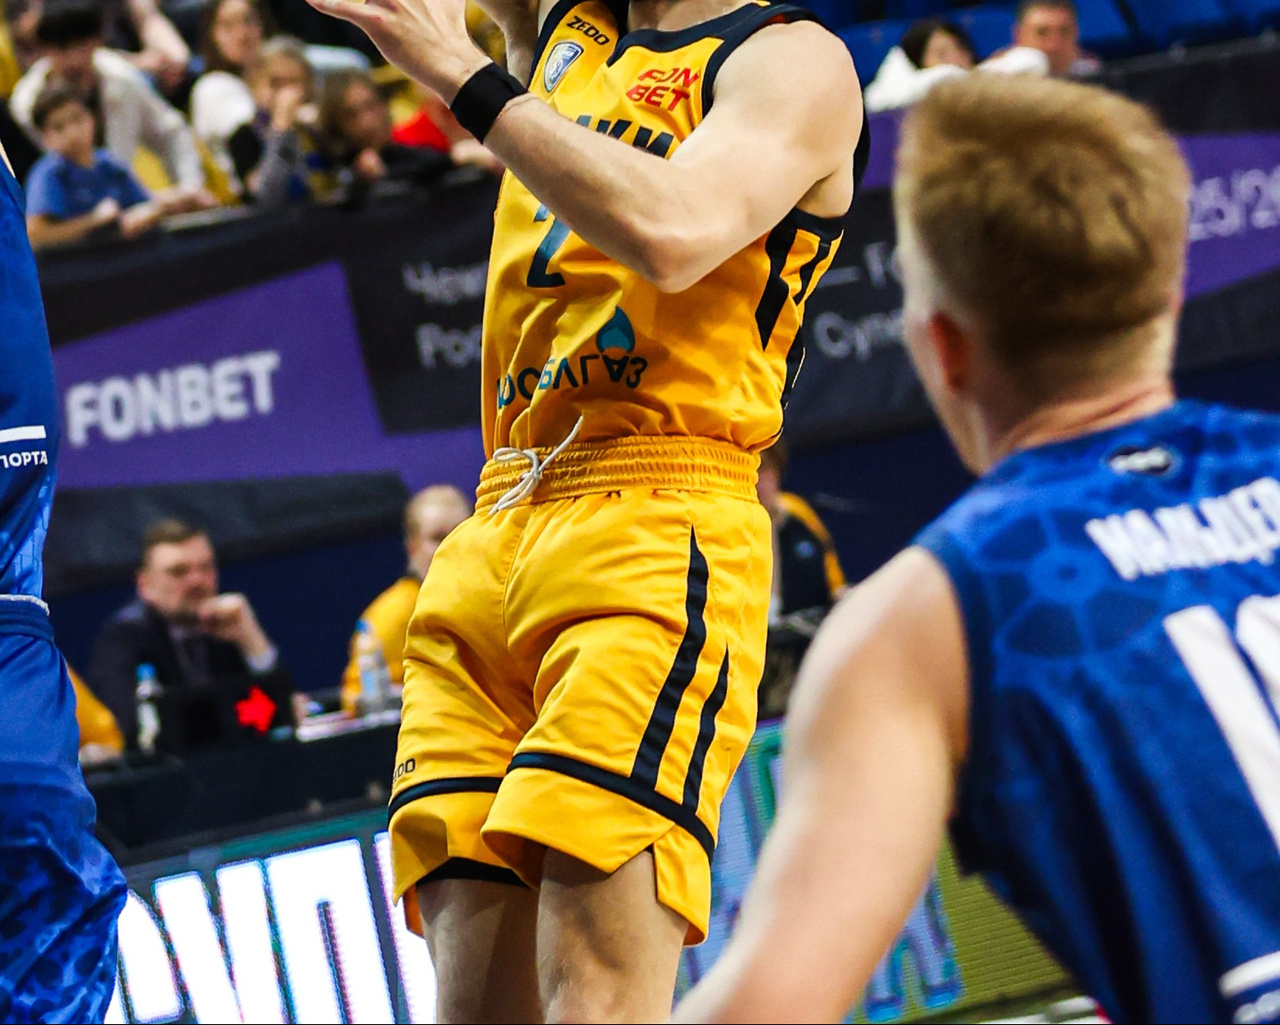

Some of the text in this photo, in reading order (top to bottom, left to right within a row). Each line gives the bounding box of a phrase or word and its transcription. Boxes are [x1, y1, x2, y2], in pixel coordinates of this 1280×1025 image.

[567, 16, 610, 46] ZEDO
[626, 85, 691, 111] BET
[66, 350, 281, 446] FONBET
